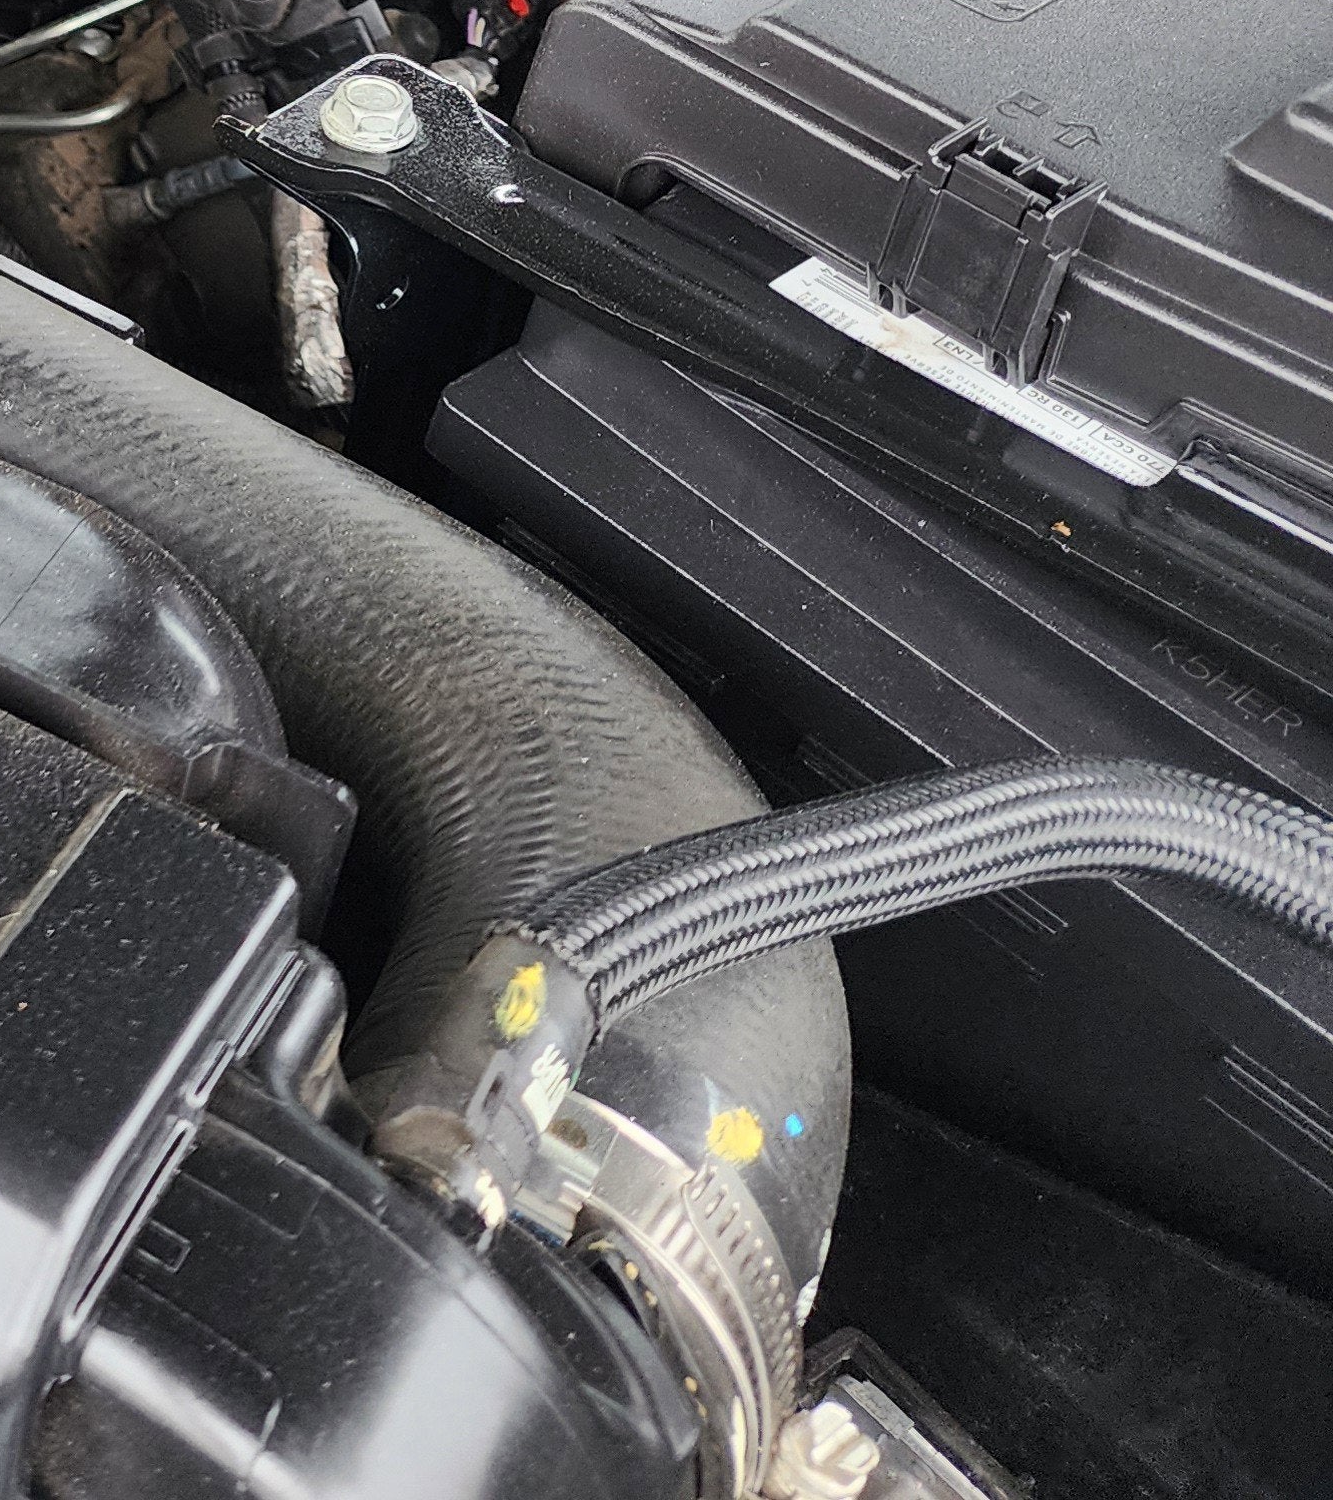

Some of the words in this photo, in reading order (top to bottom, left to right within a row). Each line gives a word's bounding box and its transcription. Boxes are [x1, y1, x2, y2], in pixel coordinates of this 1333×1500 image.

[1026, 390, 1050, 405] RC
[1052, 404, 1081, 422] 130
[1104, 432, 1134, 453] CCA
[1138, 454, 1166, 474] 770
